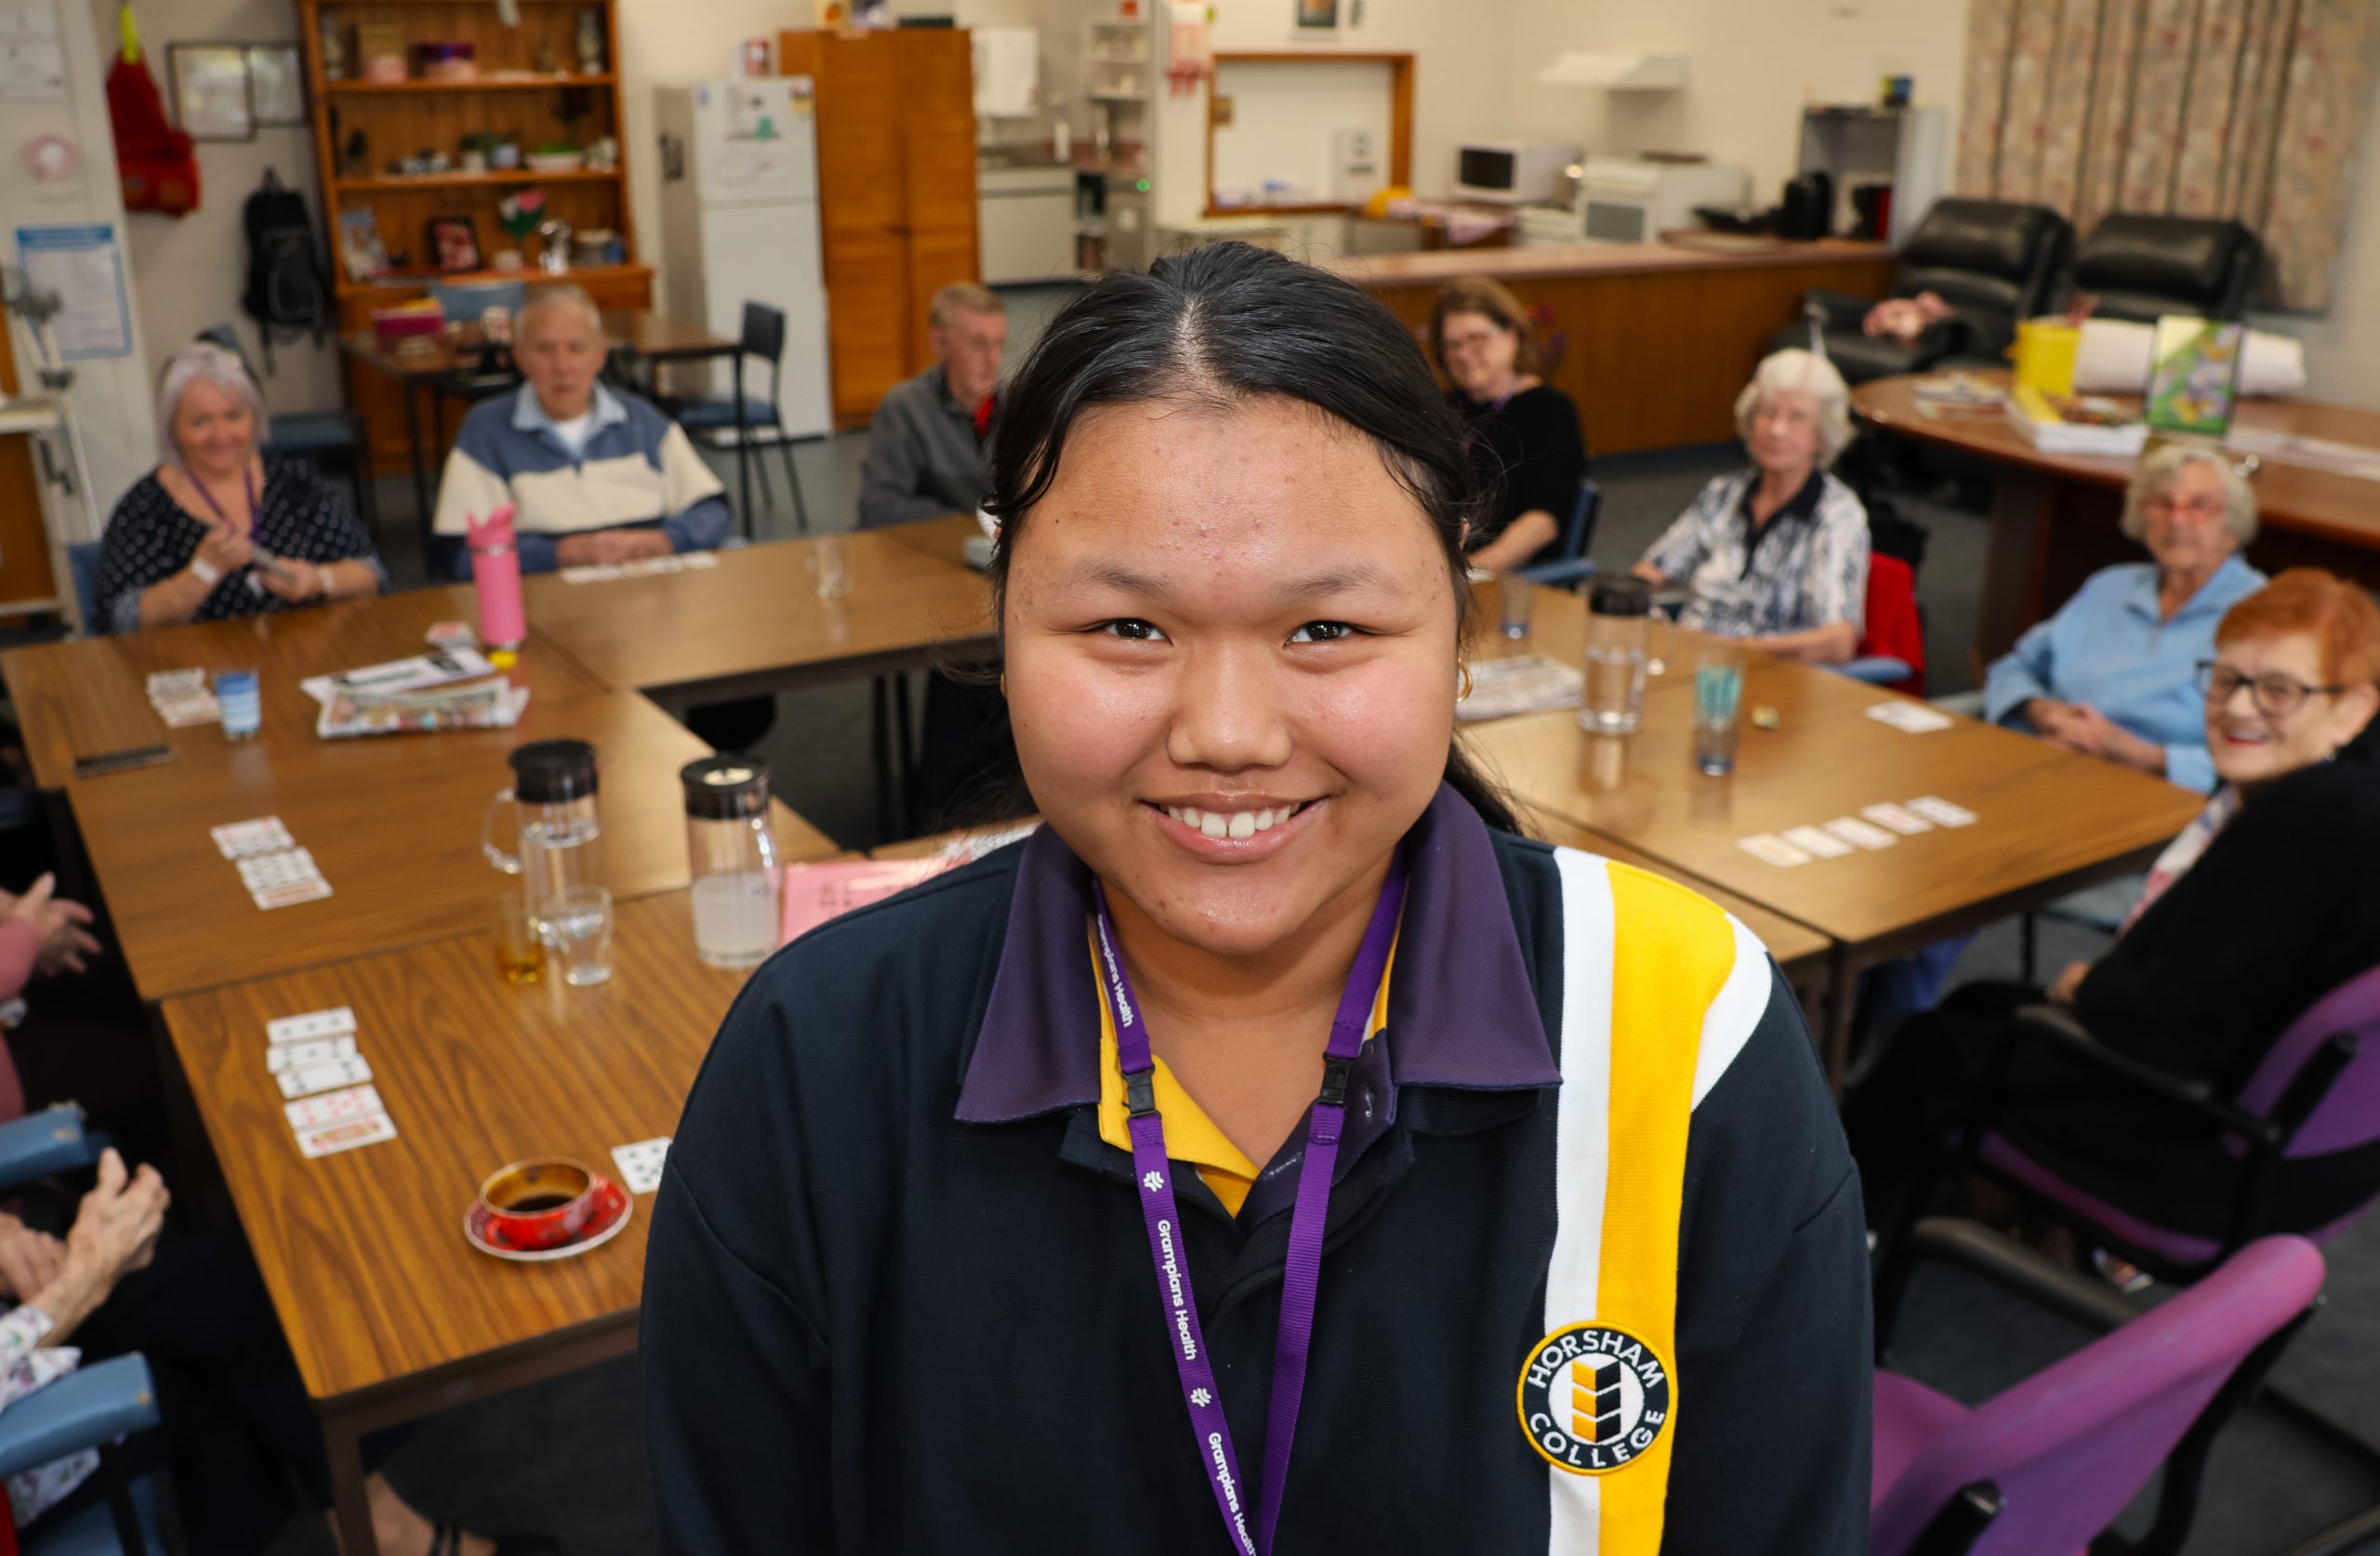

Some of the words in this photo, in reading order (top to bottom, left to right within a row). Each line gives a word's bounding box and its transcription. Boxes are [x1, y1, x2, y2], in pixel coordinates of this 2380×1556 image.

[1115, 982, 1133, 1027] Health
[1157, 1220, 1183, 1307] Grampians
[1175, 1310, 1197, 1360] Health
[1527, 1330, 1664, 1389] HORSHAM
[1530, 1410, 1664, 1467] COLLEGE
[1209, 1432, 1239, 1513] Grampians
